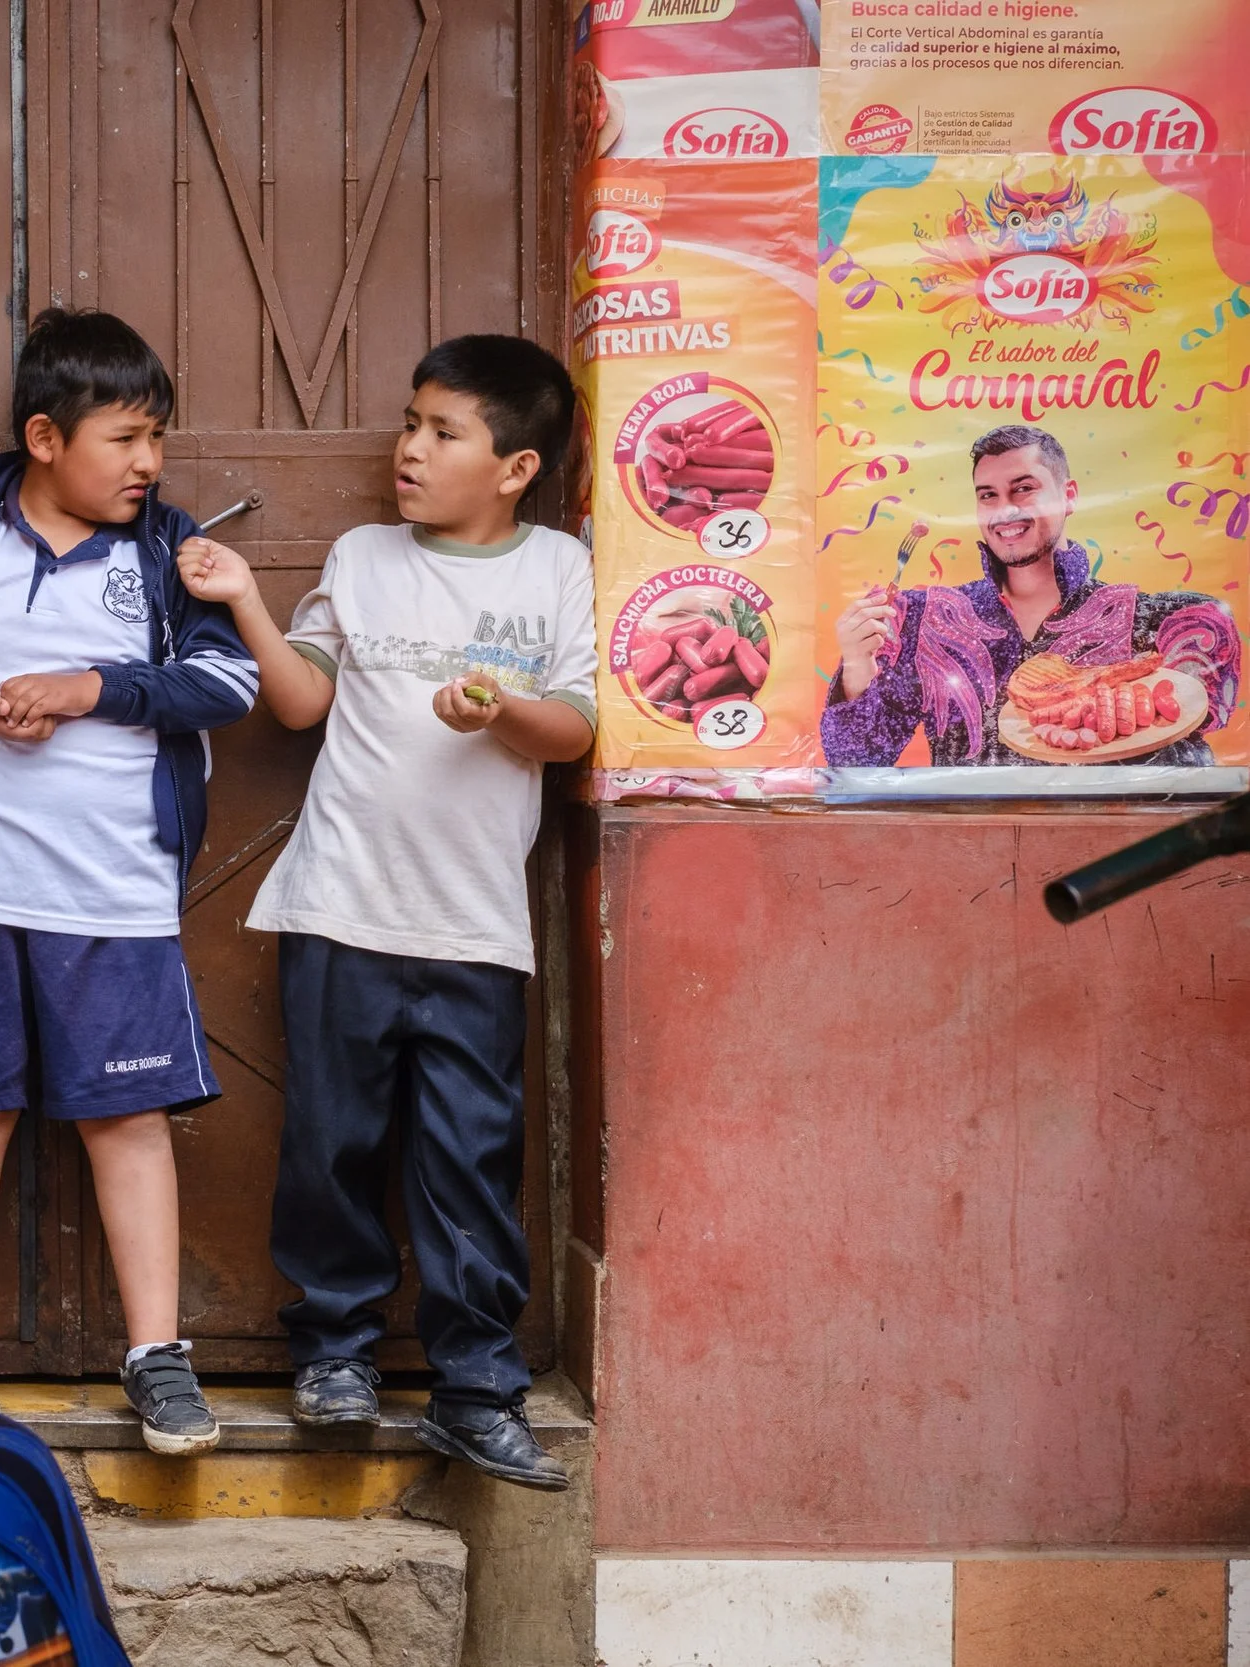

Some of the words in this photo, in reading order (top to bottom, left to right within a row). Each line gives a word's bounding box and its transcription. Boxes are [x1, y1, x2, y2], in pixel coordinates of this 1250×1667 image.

[592, 0, 625, 25] ROJO
[852, 2, 909, 17] Busca
[915, 1, 982, 17] calidad
[988, 4, 998, 17] e
[1004, 1, 1079, 21] higiene.
[851, 27, 863, 38] El
[866, 27, 902, 39] Corte
[906, 26, 955, 39] Vertical
[958, 27, 1029, 39] Abdominal
[1033, 30, 1047, 39] es
[1050, 28, 1104, 42] garantía
[850, 42, 867, 53] de
[871, 41, 920, 53] calidad
[923, 41, 979, 56] superior
[982, 44, 990, 53] e
[994, 42, 1044, 56] higiene
[1048, 43, 1059, 54] al
[1063, 42, 1120, 56] máximo,
[850, 57, 897, 70] gracias
[900, 59, 907, 68] a
[911, 57, 930, 68] los
[932, 59, 990, 71] procesos
[993, 59, 1018, 71] que
[1022, 60, 1045, 69] nos
[1048, 58, 1125, 70] diferencian.
[859, 106, 891, 121] CALIDAD
[924, 110, 942, 119] Bajo
[944, 110, 978, 118] estrictos
[979, 110, 1015, 118] Sistemas
[924, 119, 935, 127] de
[936, 119, 968, 127] Gestión
[969, 119, 980, 127] de
[982, 119, 1013, 127] Calidad
[679, 123, 775, 158] Sofía
[847, 121, 911, 146] GARANTÍA
[923, 138, 961, 146] certifican
[962, 138, 970, 146] la
[971, 138, 1011, 146] inocuidad
[1069, 107, 1199, 154] Sofía
[991, 268, 1087, 307] Sofía
[967, 340, 991, 364] El
[996, 338, 1056, 364] sabor
[1061, 339, 1100, 363] del
[908, 348, 1161, 422] Carnaval
[616, 402, 654, 453] VIENA
[650, 377, 696, 406] ROJA
[718, 520, 752, 548] 36
[473, 610, 547, 648] BALI
[613, 579, 668, 667] SALCHICHA
[670, 567, 765, 607] COCTELERA
[713, 709, 748, 737] 38
